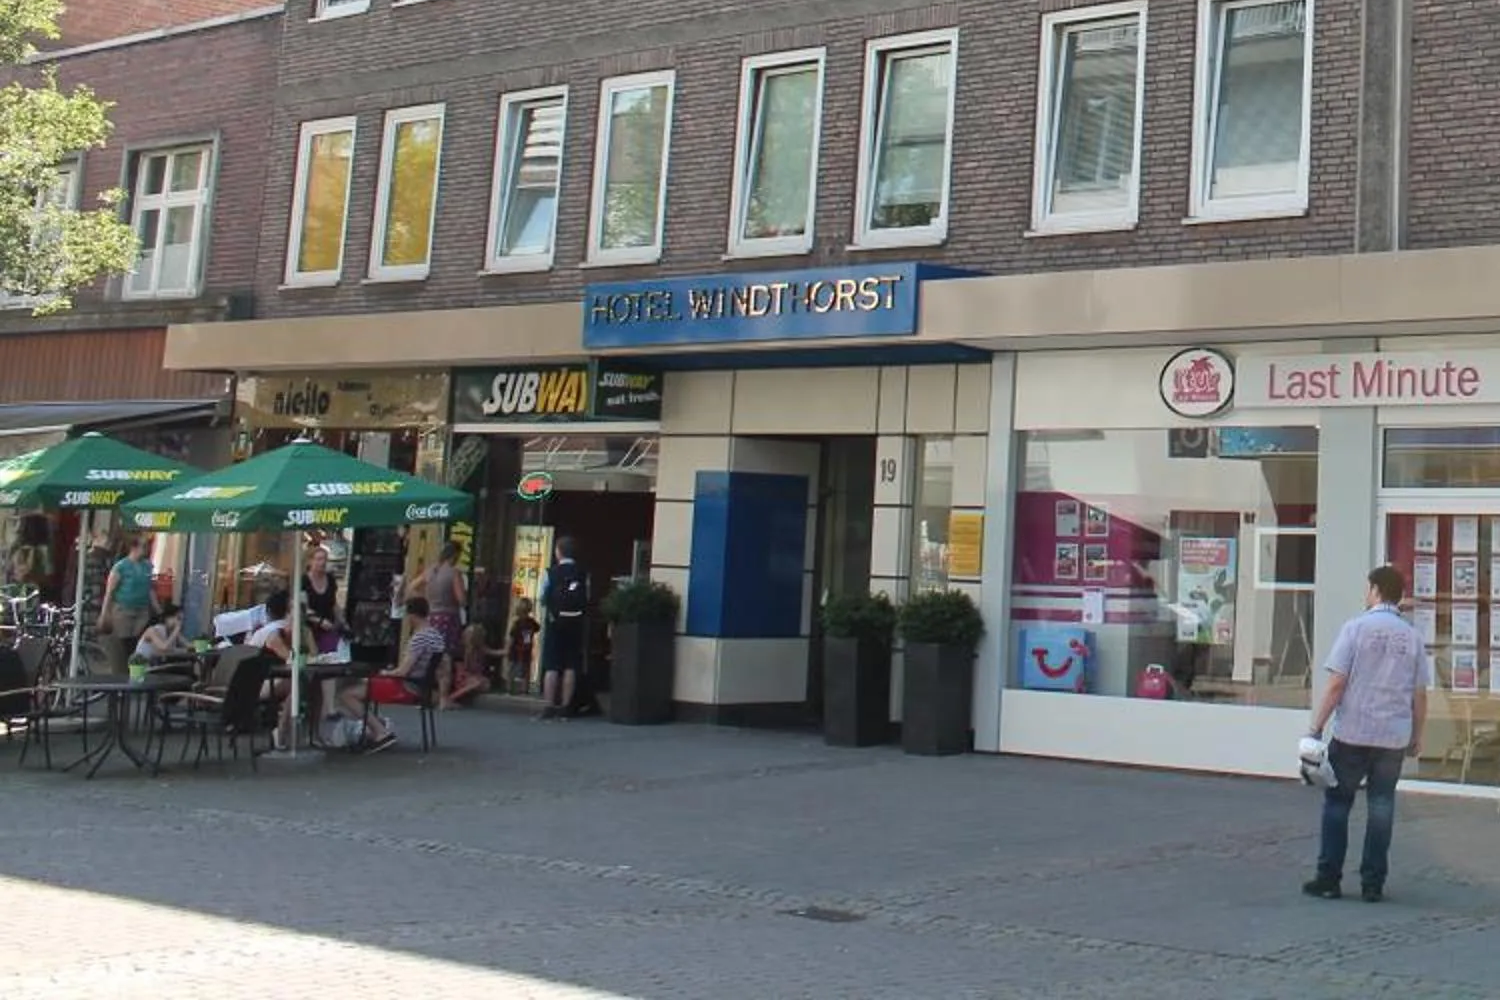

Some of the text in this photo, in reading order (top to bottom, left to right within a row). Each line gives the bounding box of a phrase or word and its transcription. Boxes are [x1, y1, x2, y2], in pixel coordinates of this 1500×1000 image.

[592, 276, 903, 326] HOTEL WINDTHORST
[598, 371, 656, 390] SUBWAY
[1267, 358, 1480, 400] Last Minute
[85, 468, 182, 481] SUBWAY
[879, 457, 897, 483] 19
[60, 490, 125, 506] SUBWAY
[305, 480, 404, 497] SUBWAY
[282, 508, 349, 527] SUBWAY
